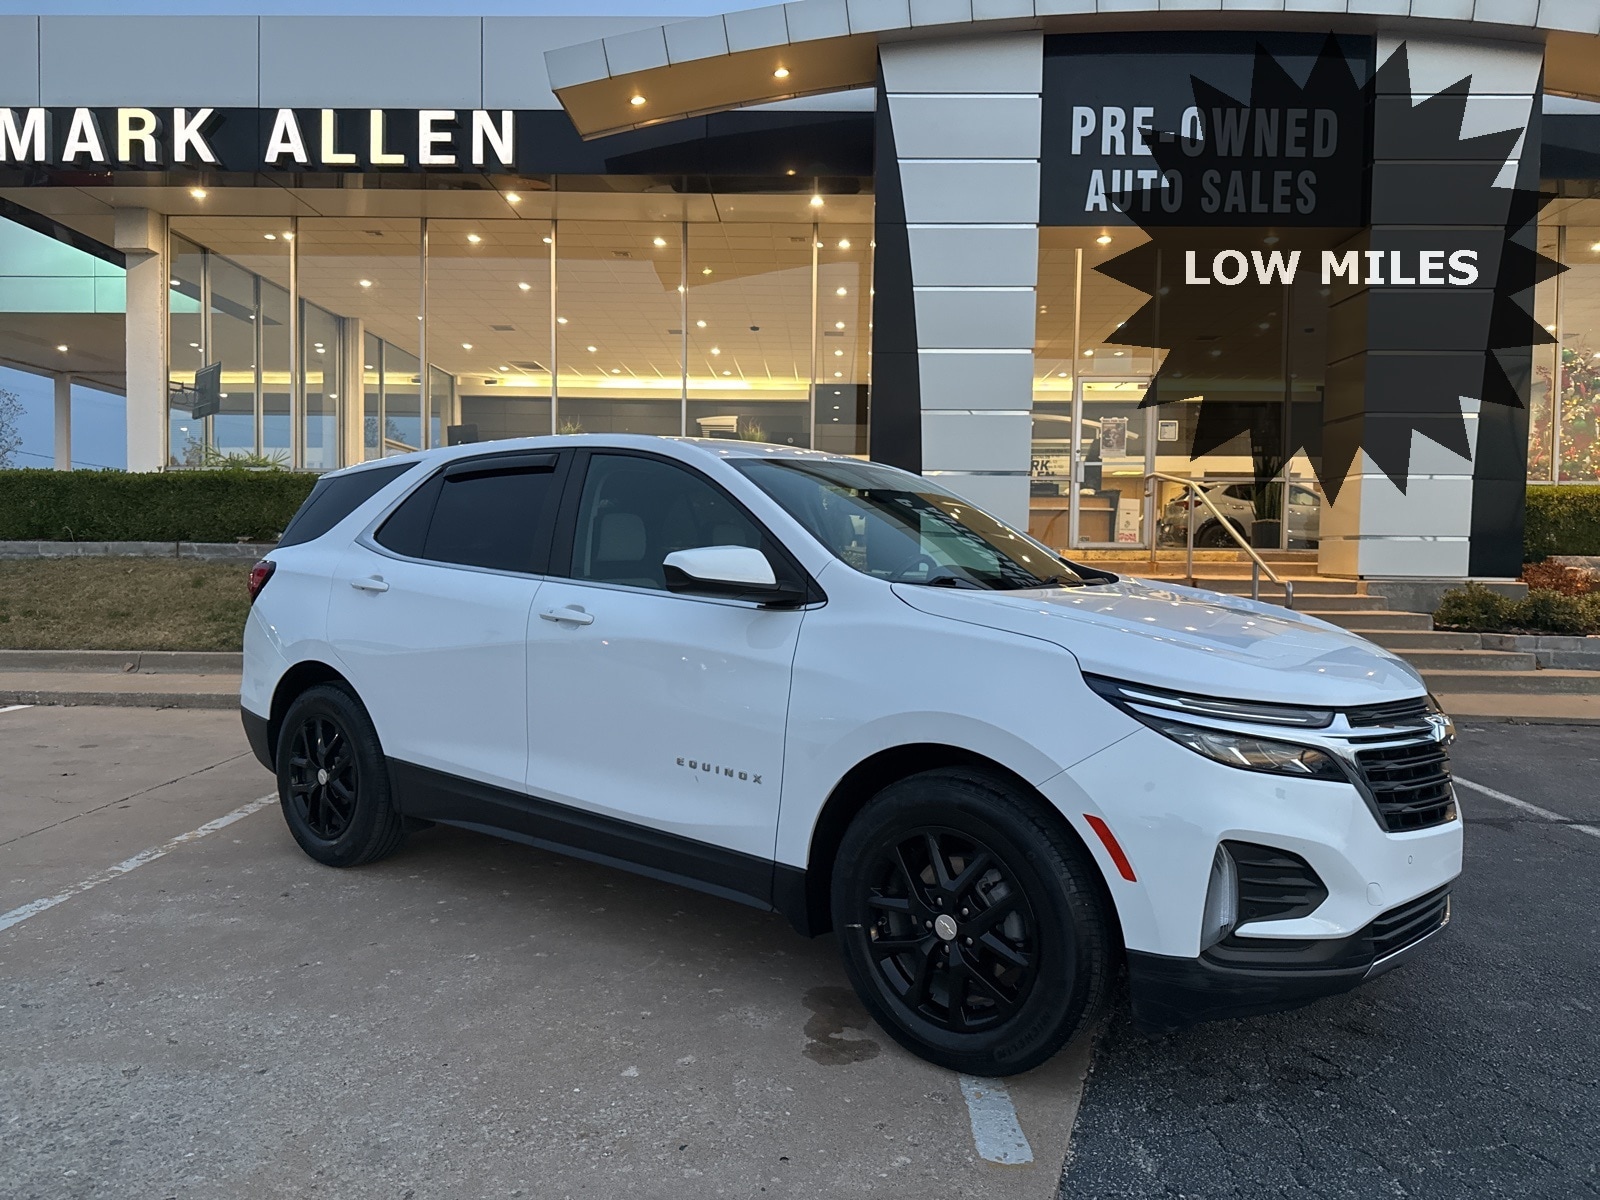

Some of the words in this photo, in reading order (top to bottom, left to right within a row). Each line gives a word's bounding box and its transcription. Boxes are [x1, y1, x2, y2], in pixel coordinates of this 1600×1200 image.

[0, 107, 218, 162] MARK
[265, 109, 515, 165] ALLEN
[1071, 105, 1338, 158] PRE-OWNED
[1085, 169, 1183, 213] AUTO
[1200, 170, 1317, 214] SALES
[1032, 460, 1050, 471] RK
[676, 757, 762, 784] EQUINOX
